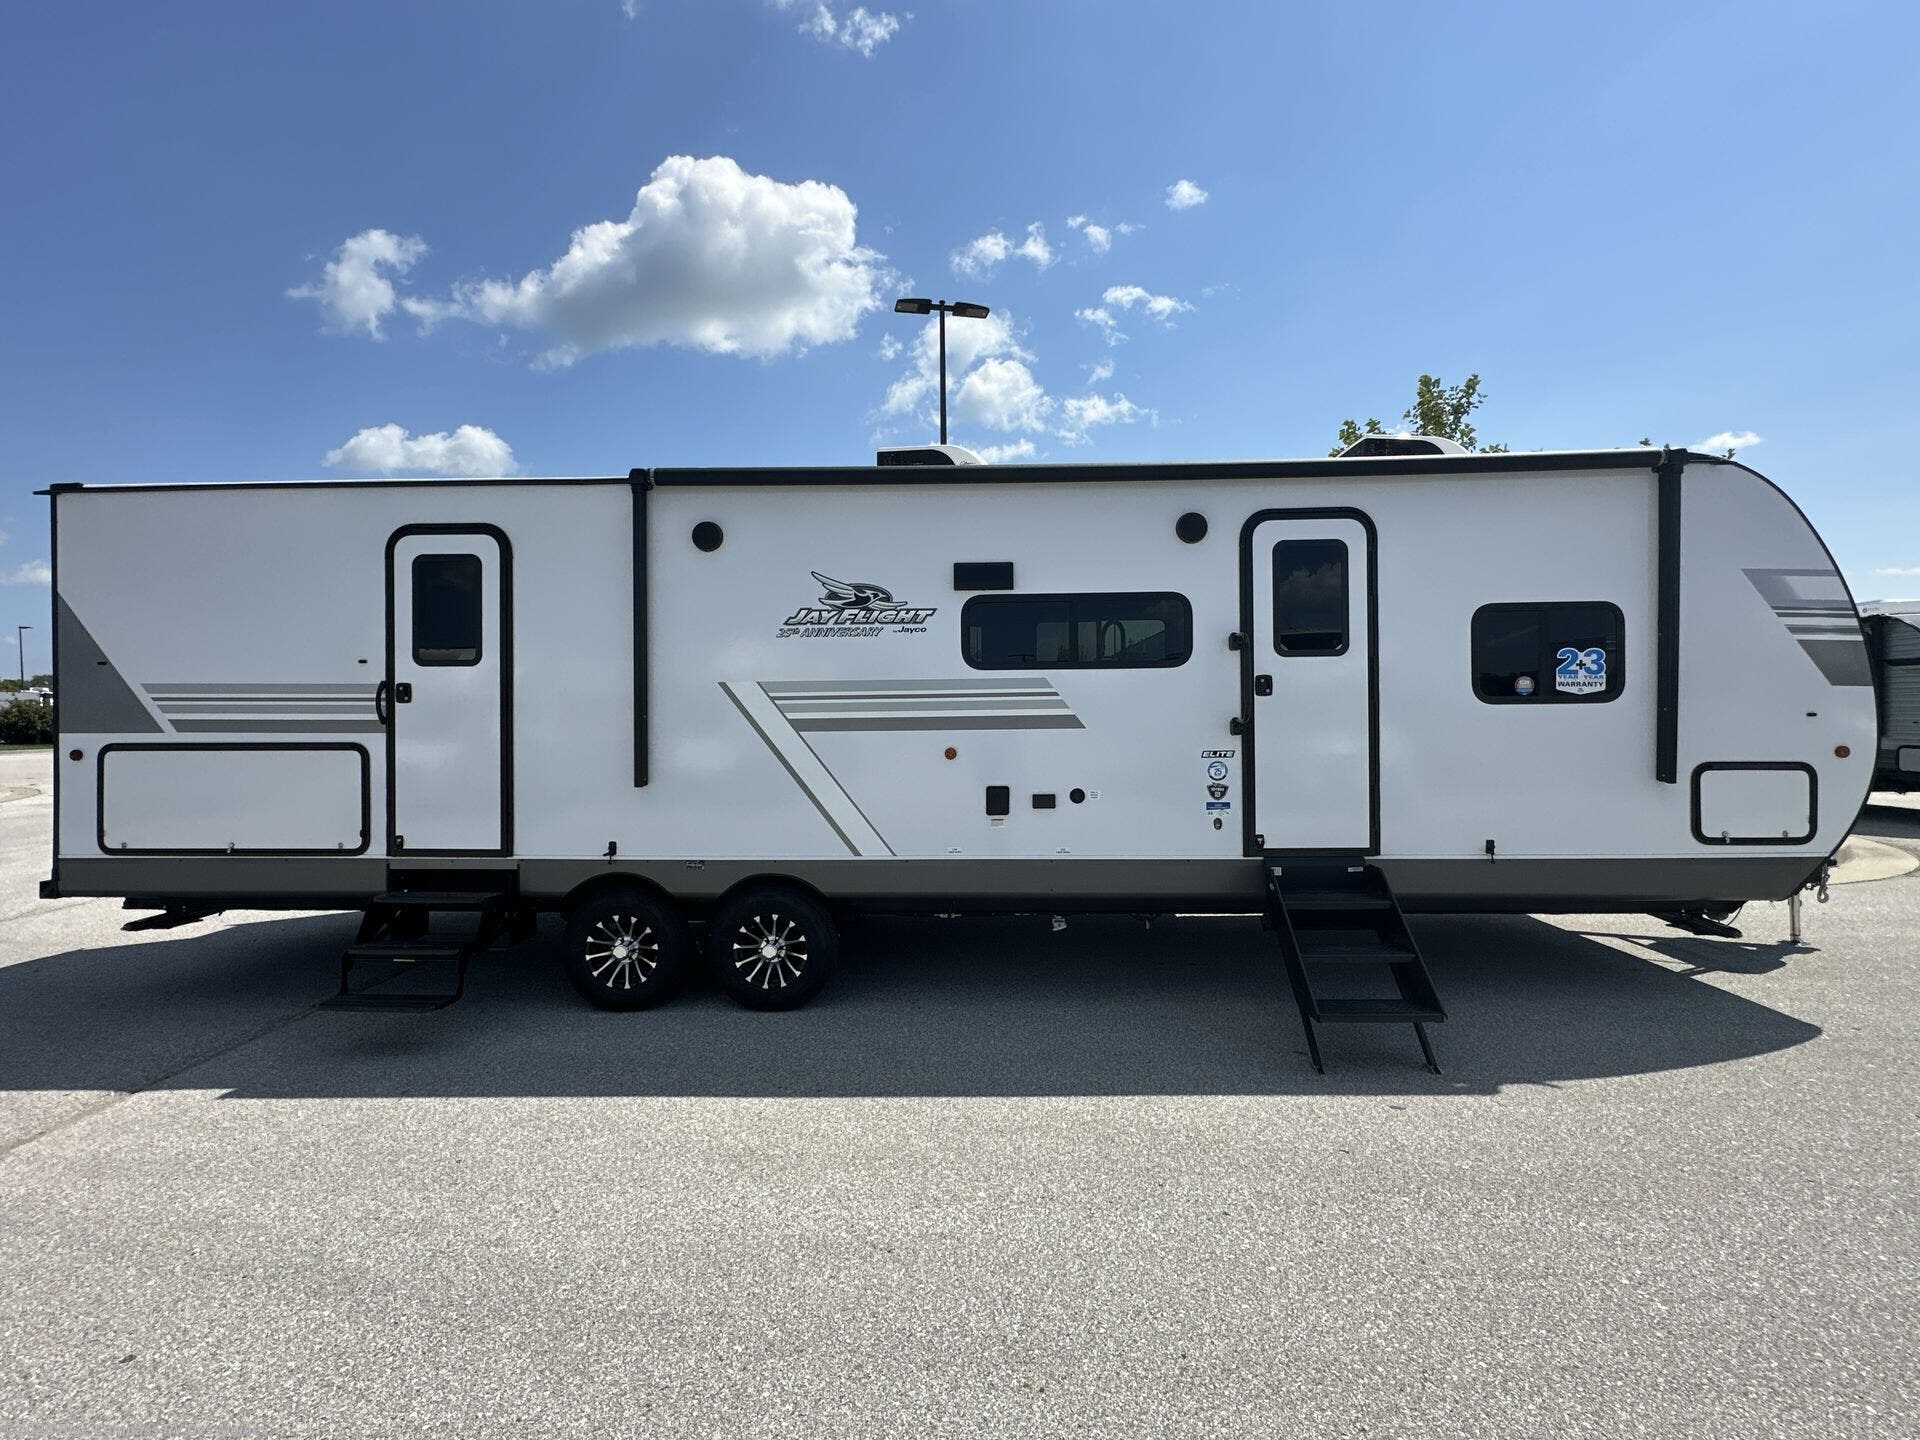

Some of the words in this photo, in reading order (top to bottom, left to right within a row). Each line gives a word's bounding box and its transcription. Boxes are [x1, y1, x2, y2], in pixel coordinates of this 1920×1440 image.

[784, 608, 840, 625] JAY
[833, 608, 937, 625] FLIGHT
[800, 626, 884, 638] ANNIVERSARY
[897, 626, 927, 634] Jayco
